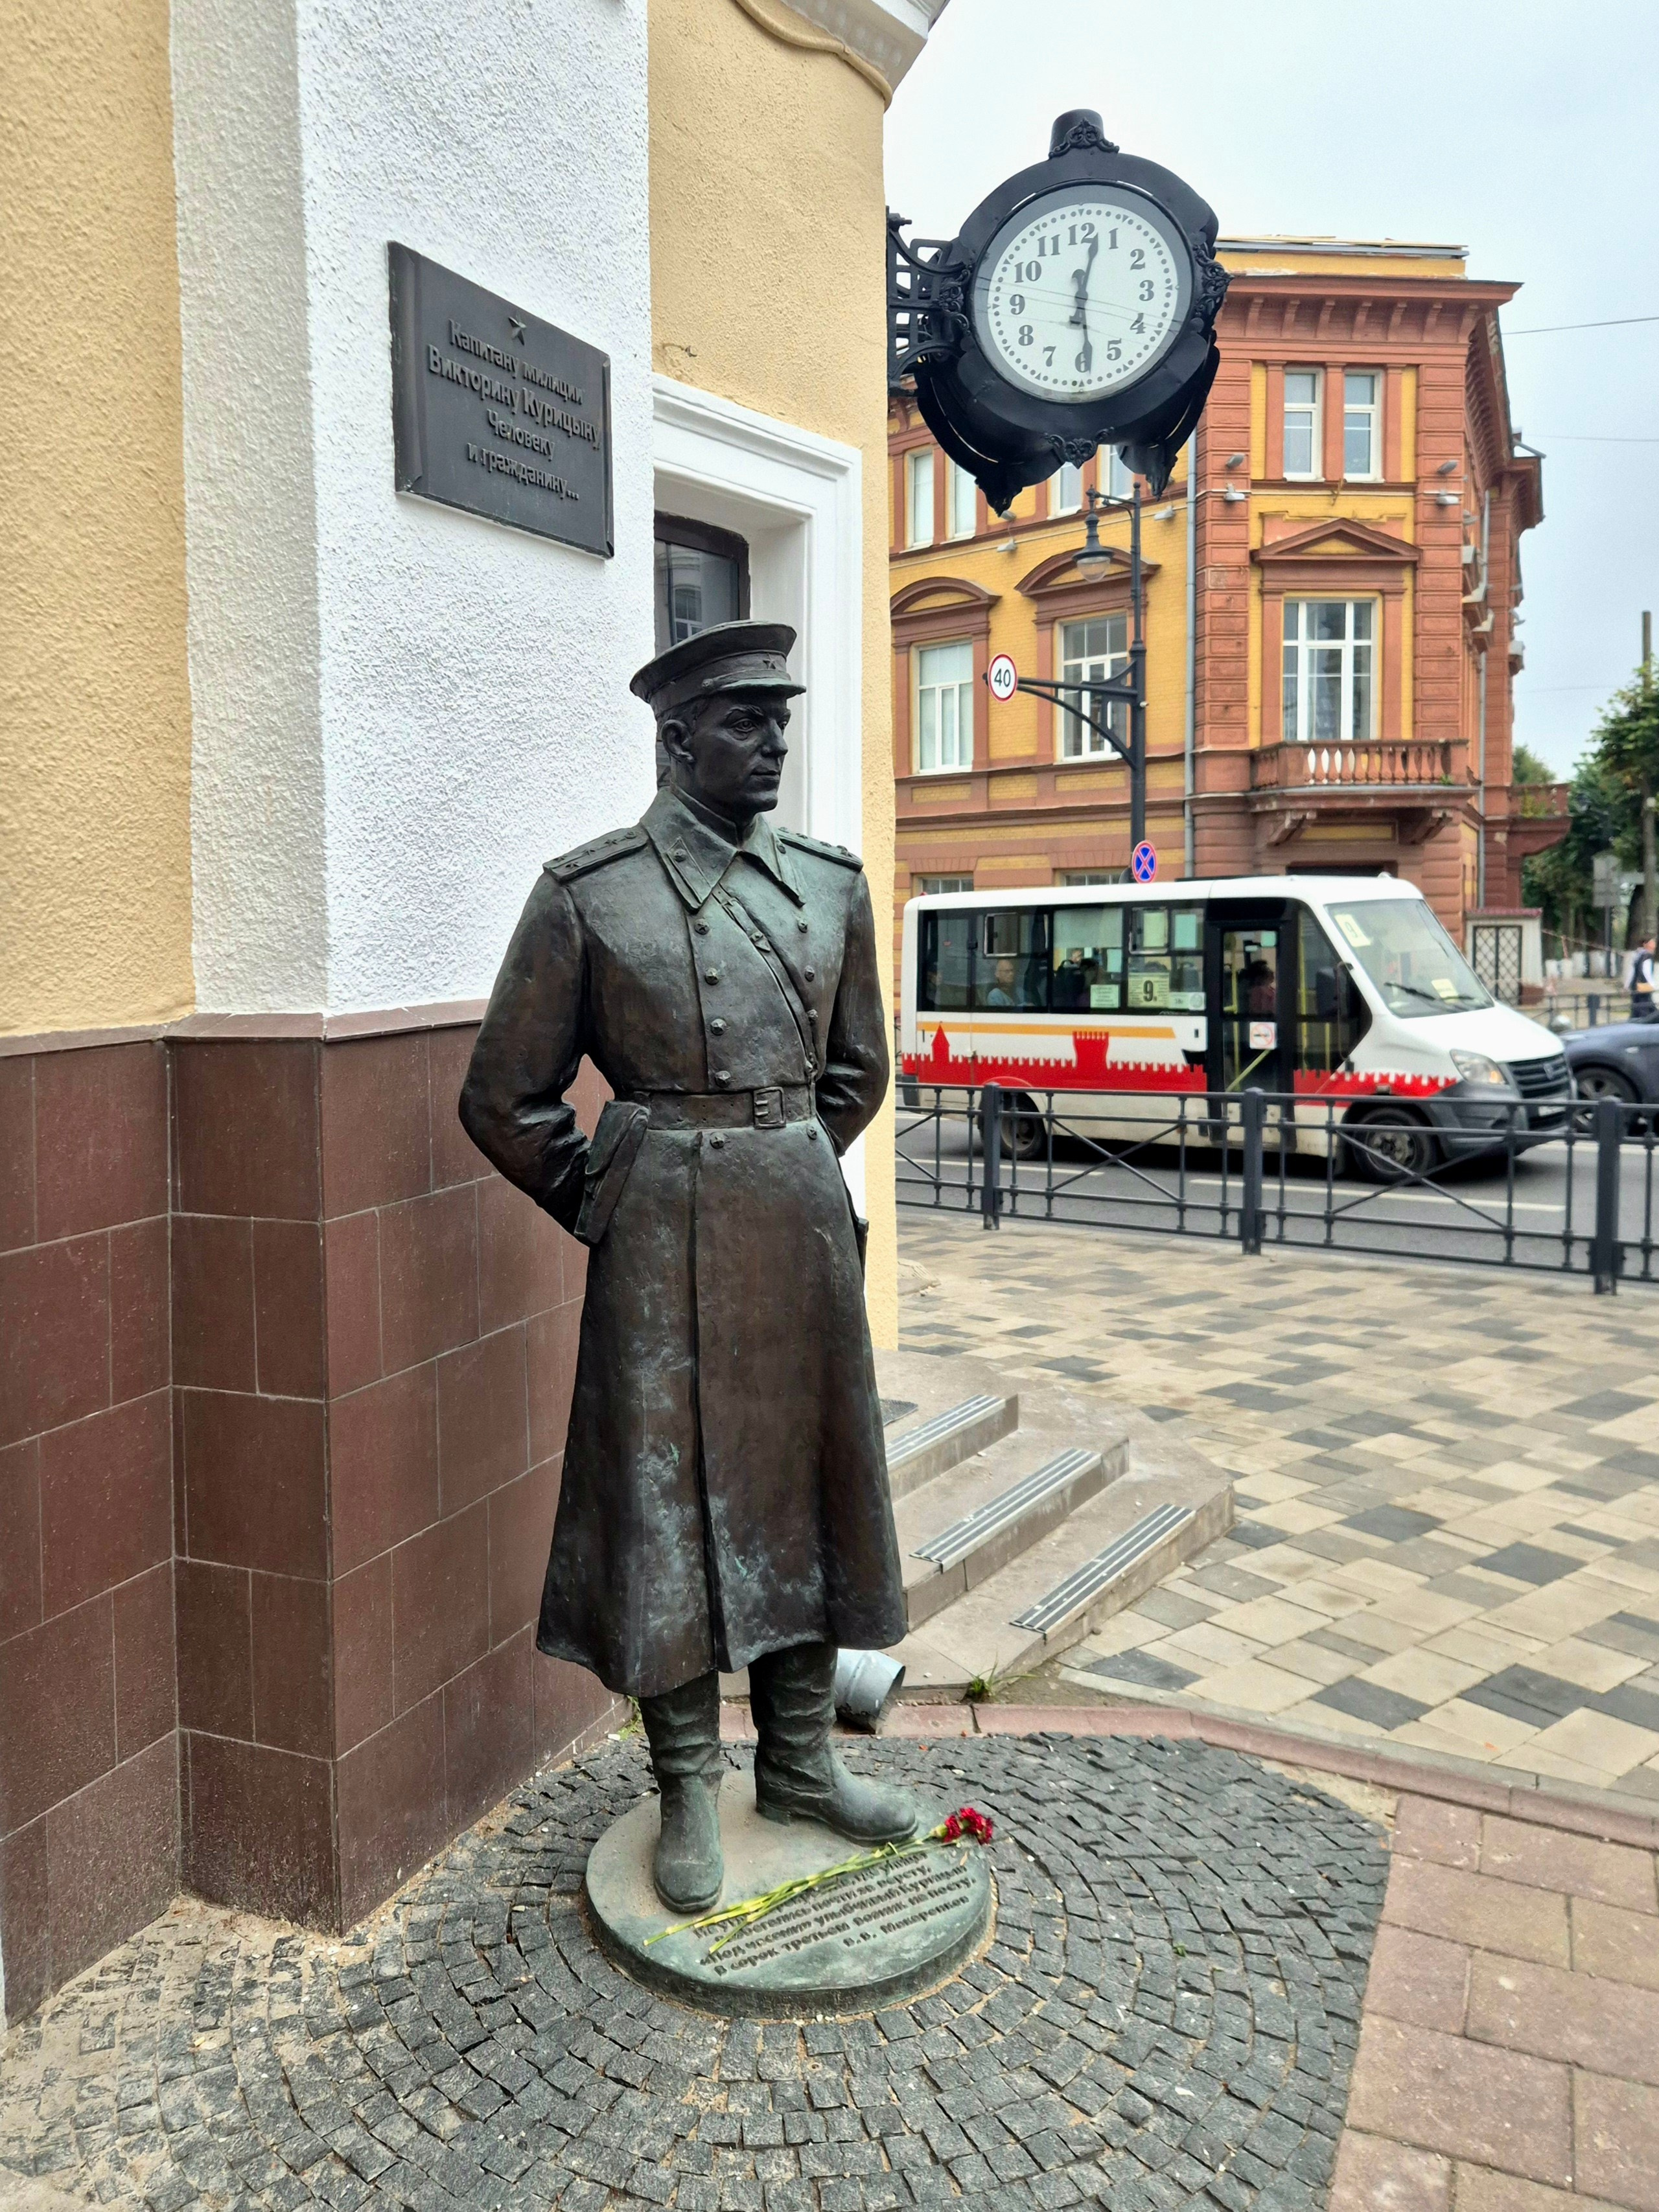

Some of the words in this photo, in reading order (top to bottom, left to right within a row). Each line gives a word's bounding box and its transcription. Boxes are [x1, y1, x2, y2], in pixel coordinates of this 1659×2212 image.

[1067, 222, 1096, 246] 12
[1109, 228, 1119, 249] 1
[1038, 234, 1061, 257] 11
[1130, 249, 1146, 270] 2
[1014, 260, 1042, 283] 10
[1139, 280, 1154, 301] 3
[1009, 294, 1026, 315] 9
[1130, 313, 1146, 334] 4
[1018, 325, 1034, 346] 8
[1043, 346, 1056, 367] 7
[1106, 339, 1122, 361] 5
[448, 318, 519, 379] Капитану
[523, 361, 583, 405] милиции
[1074, 351, 1091, 373] 6
[428, 343, 519, 415] Викторину
[487, 409, 555, 462] Человеку
[467, 443, 478, 463] и
[994, 668, 1011, 687] 40
